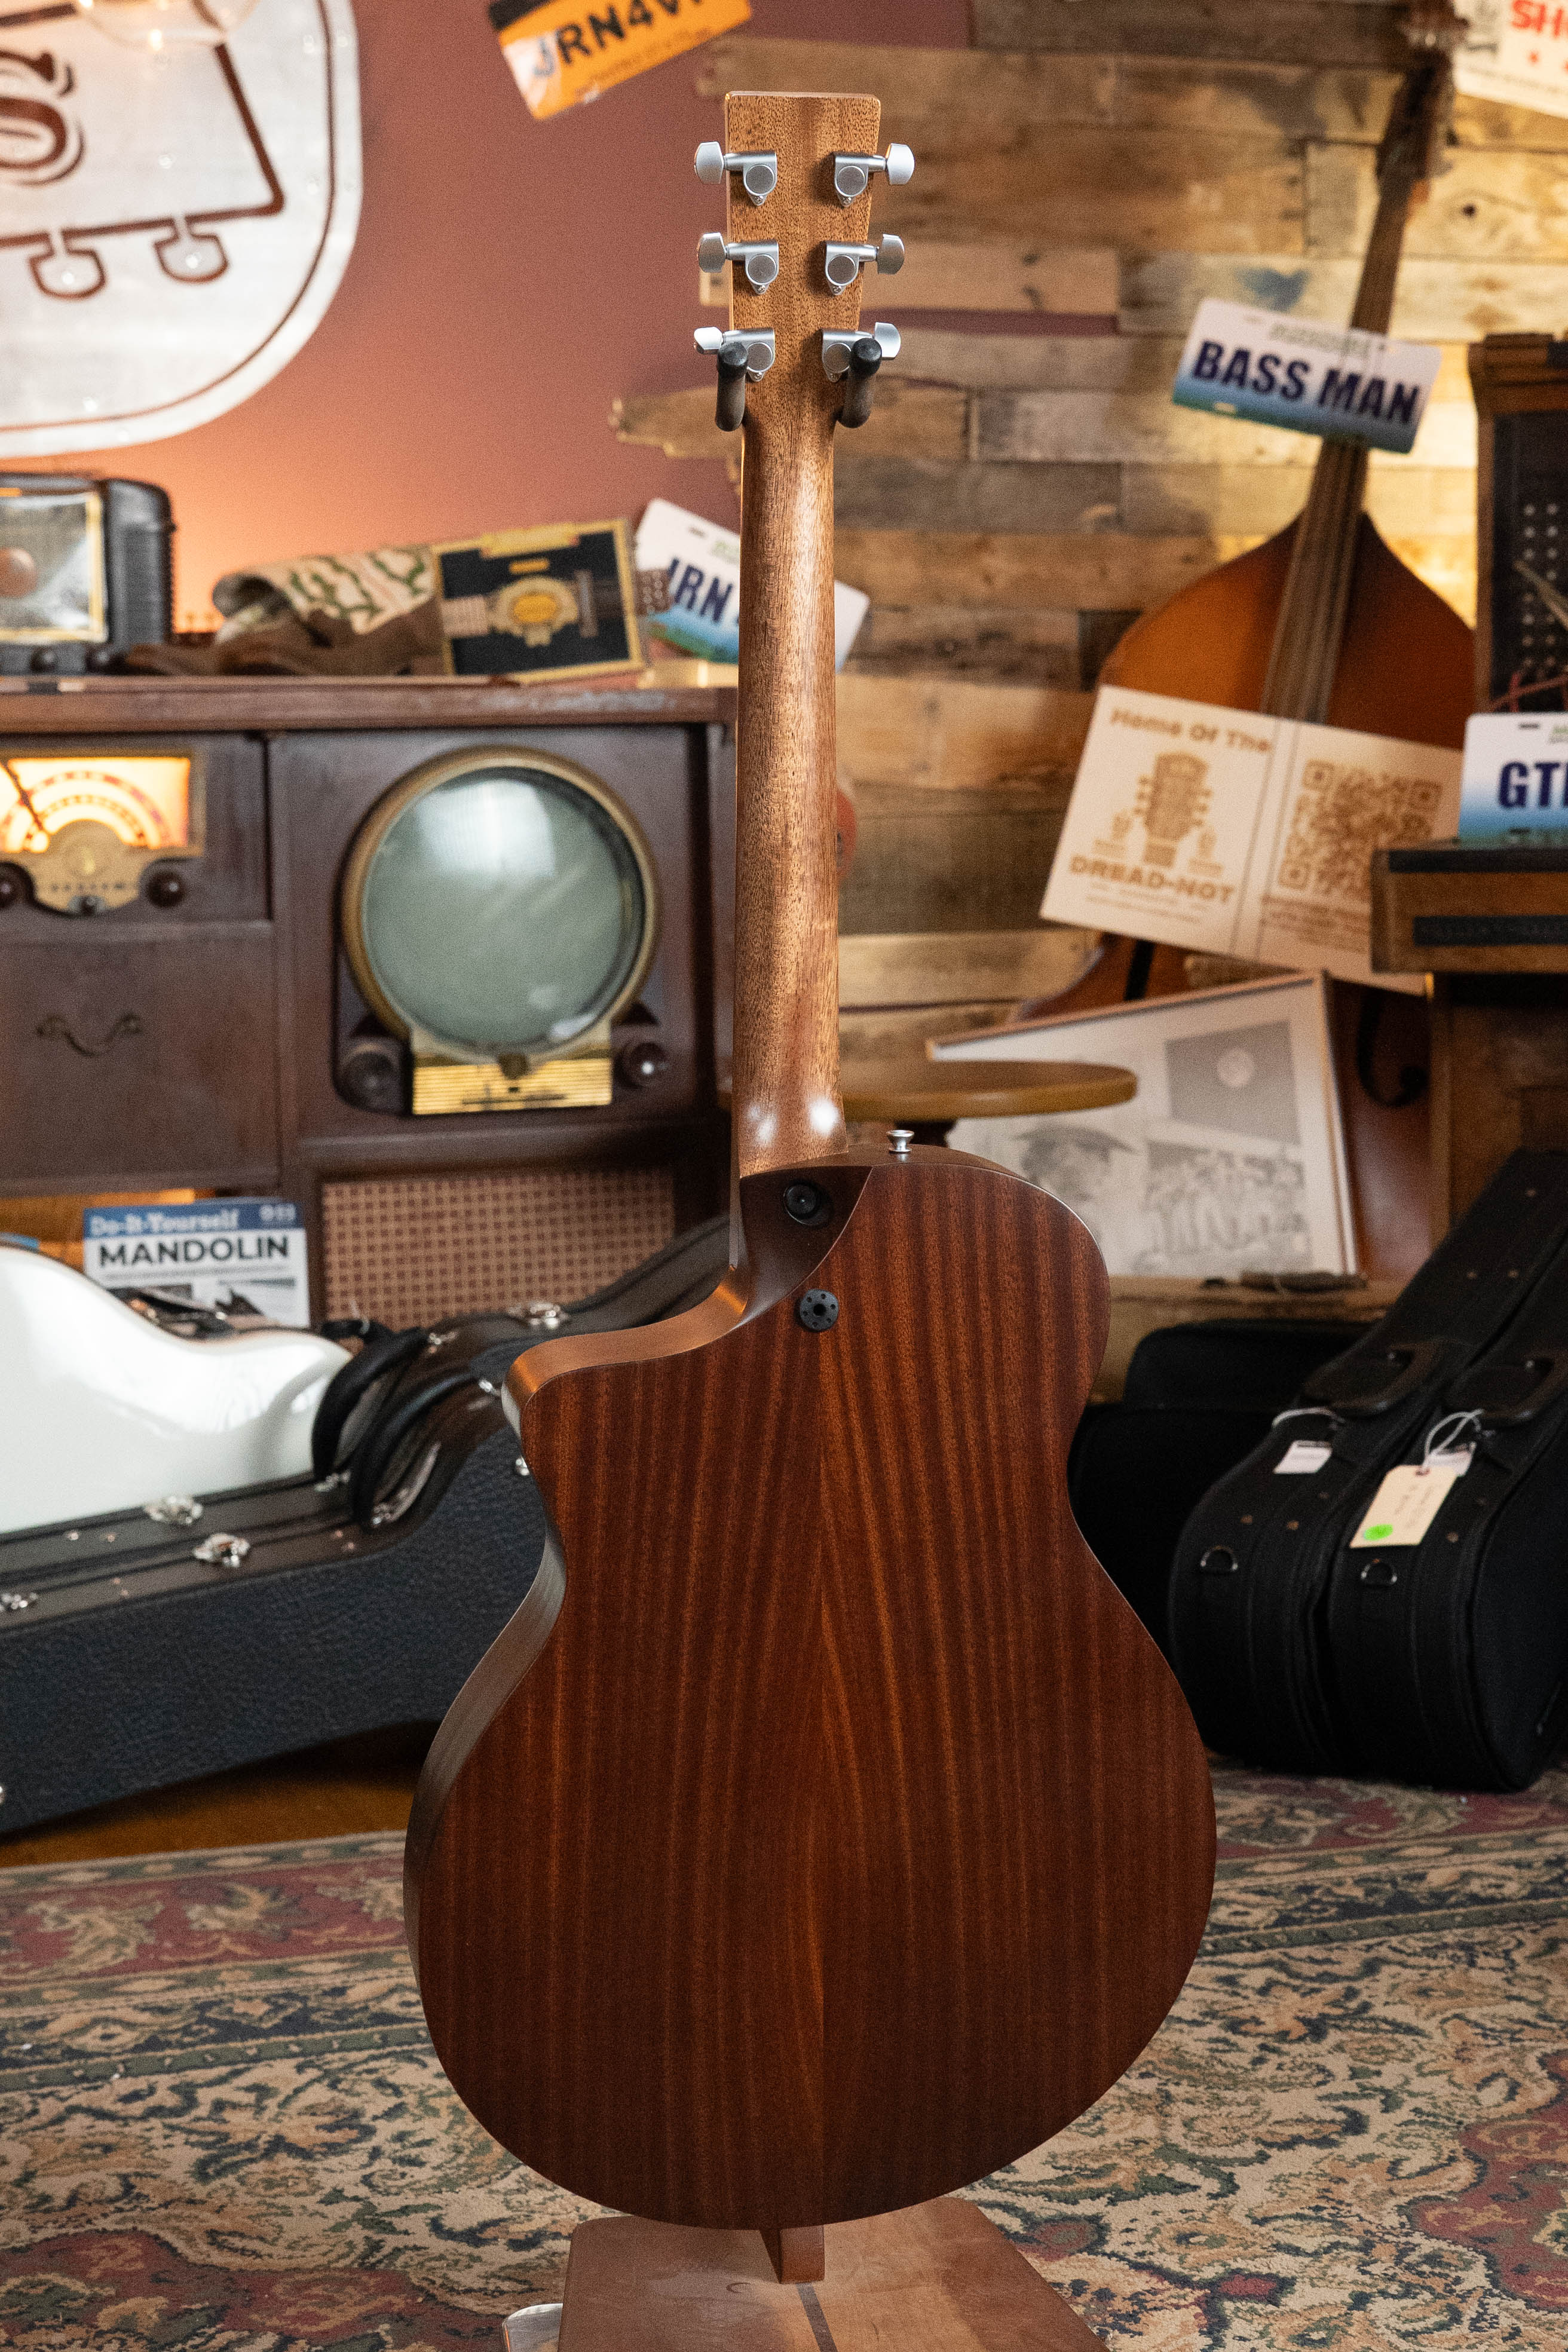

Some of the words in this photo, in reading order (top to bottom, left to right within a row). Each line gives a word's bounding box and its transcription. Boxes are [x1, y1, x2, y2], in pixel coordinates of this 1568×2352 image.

[533, 0, 702, 77] JRN4
[1193, 339, 1310, 401] BASS
[1319, 368, 1420, 423] MAN
[1498, 761, 1568, 808] GT
[99, 1235, 289, 1266] MANDOLIN
